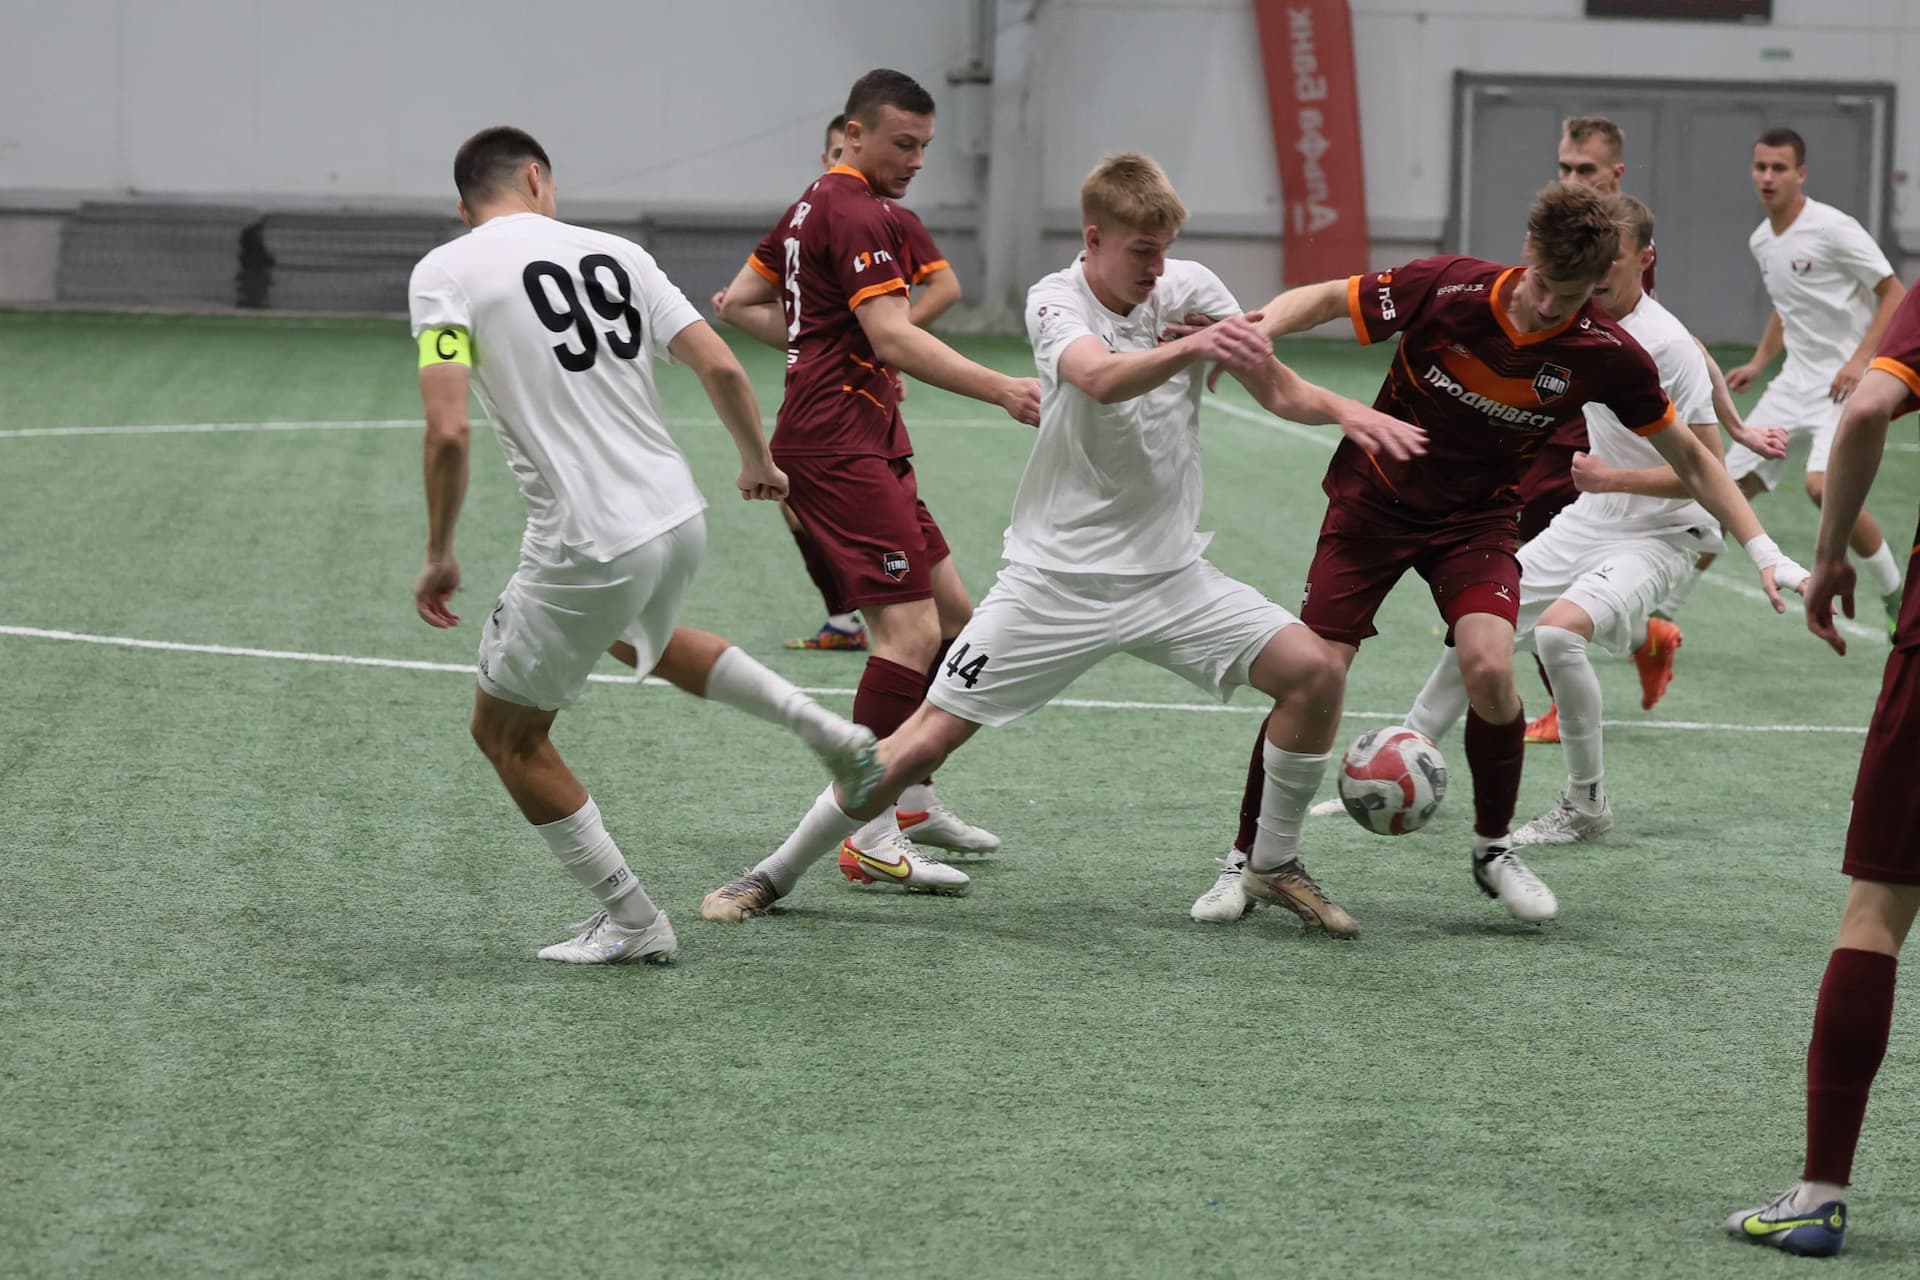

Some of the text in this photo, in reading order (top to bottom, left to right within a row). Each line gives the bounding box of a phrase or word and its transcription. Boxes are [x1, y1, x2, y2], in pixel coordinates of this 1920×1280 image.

[523, 253, 642, 372] 99
[1377, 286, 1397, 321] ПСБ
[435, 329, 459, 361] C
[1423, 364, 1555, 428] ПРОДИНВЕСТ
[1537, 374, 1566, 393] ТЕМП
[945, 642, 990, 690] 44
[607, 867, 629, 888] 99
